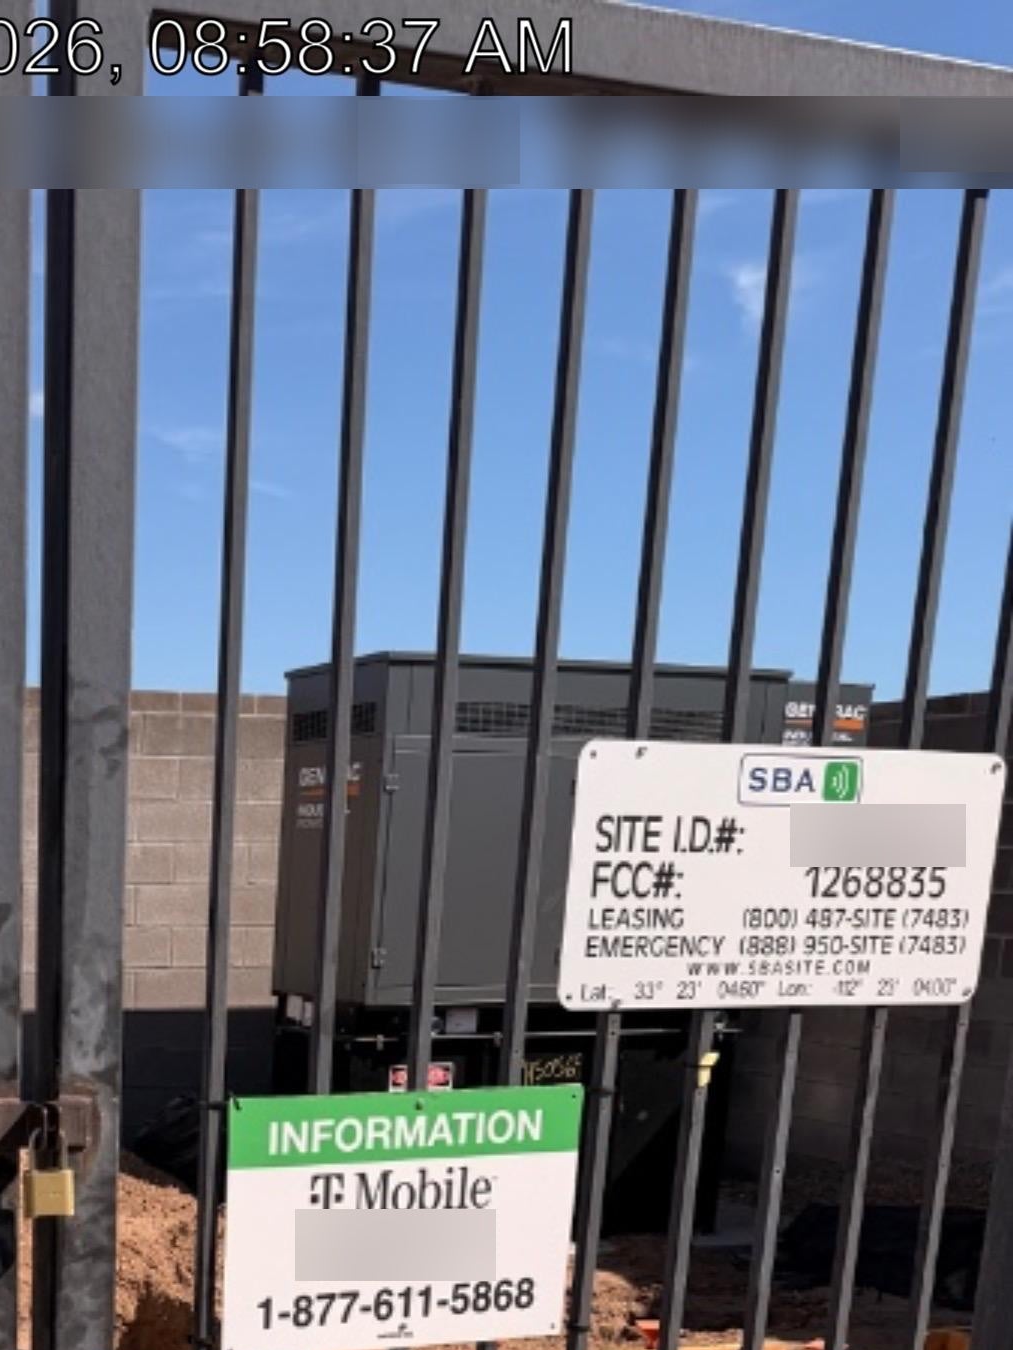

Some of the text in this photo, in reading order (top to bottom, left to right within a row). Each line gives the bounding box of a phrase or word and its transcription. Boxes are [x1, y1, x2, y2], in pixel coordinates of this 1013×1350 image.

[748, 767, 817, 793] SBA
[595, 815, 747, 855] SITE I.D.#:
[591, 861, 948, 899] FCC#: 1268835
[588, 908, 970, 931] LEASING (800) 487-SITE (7483)
[585, 936, 967, 958] EMERGENCY (888) 950-SITE (7483)
[687, 960, 871, 976] WWW.SBASITE.COM
[268, 1109, 544, 1156] INFORMATION
[257, 1276, 536, 1330] 1-877-611-5868
